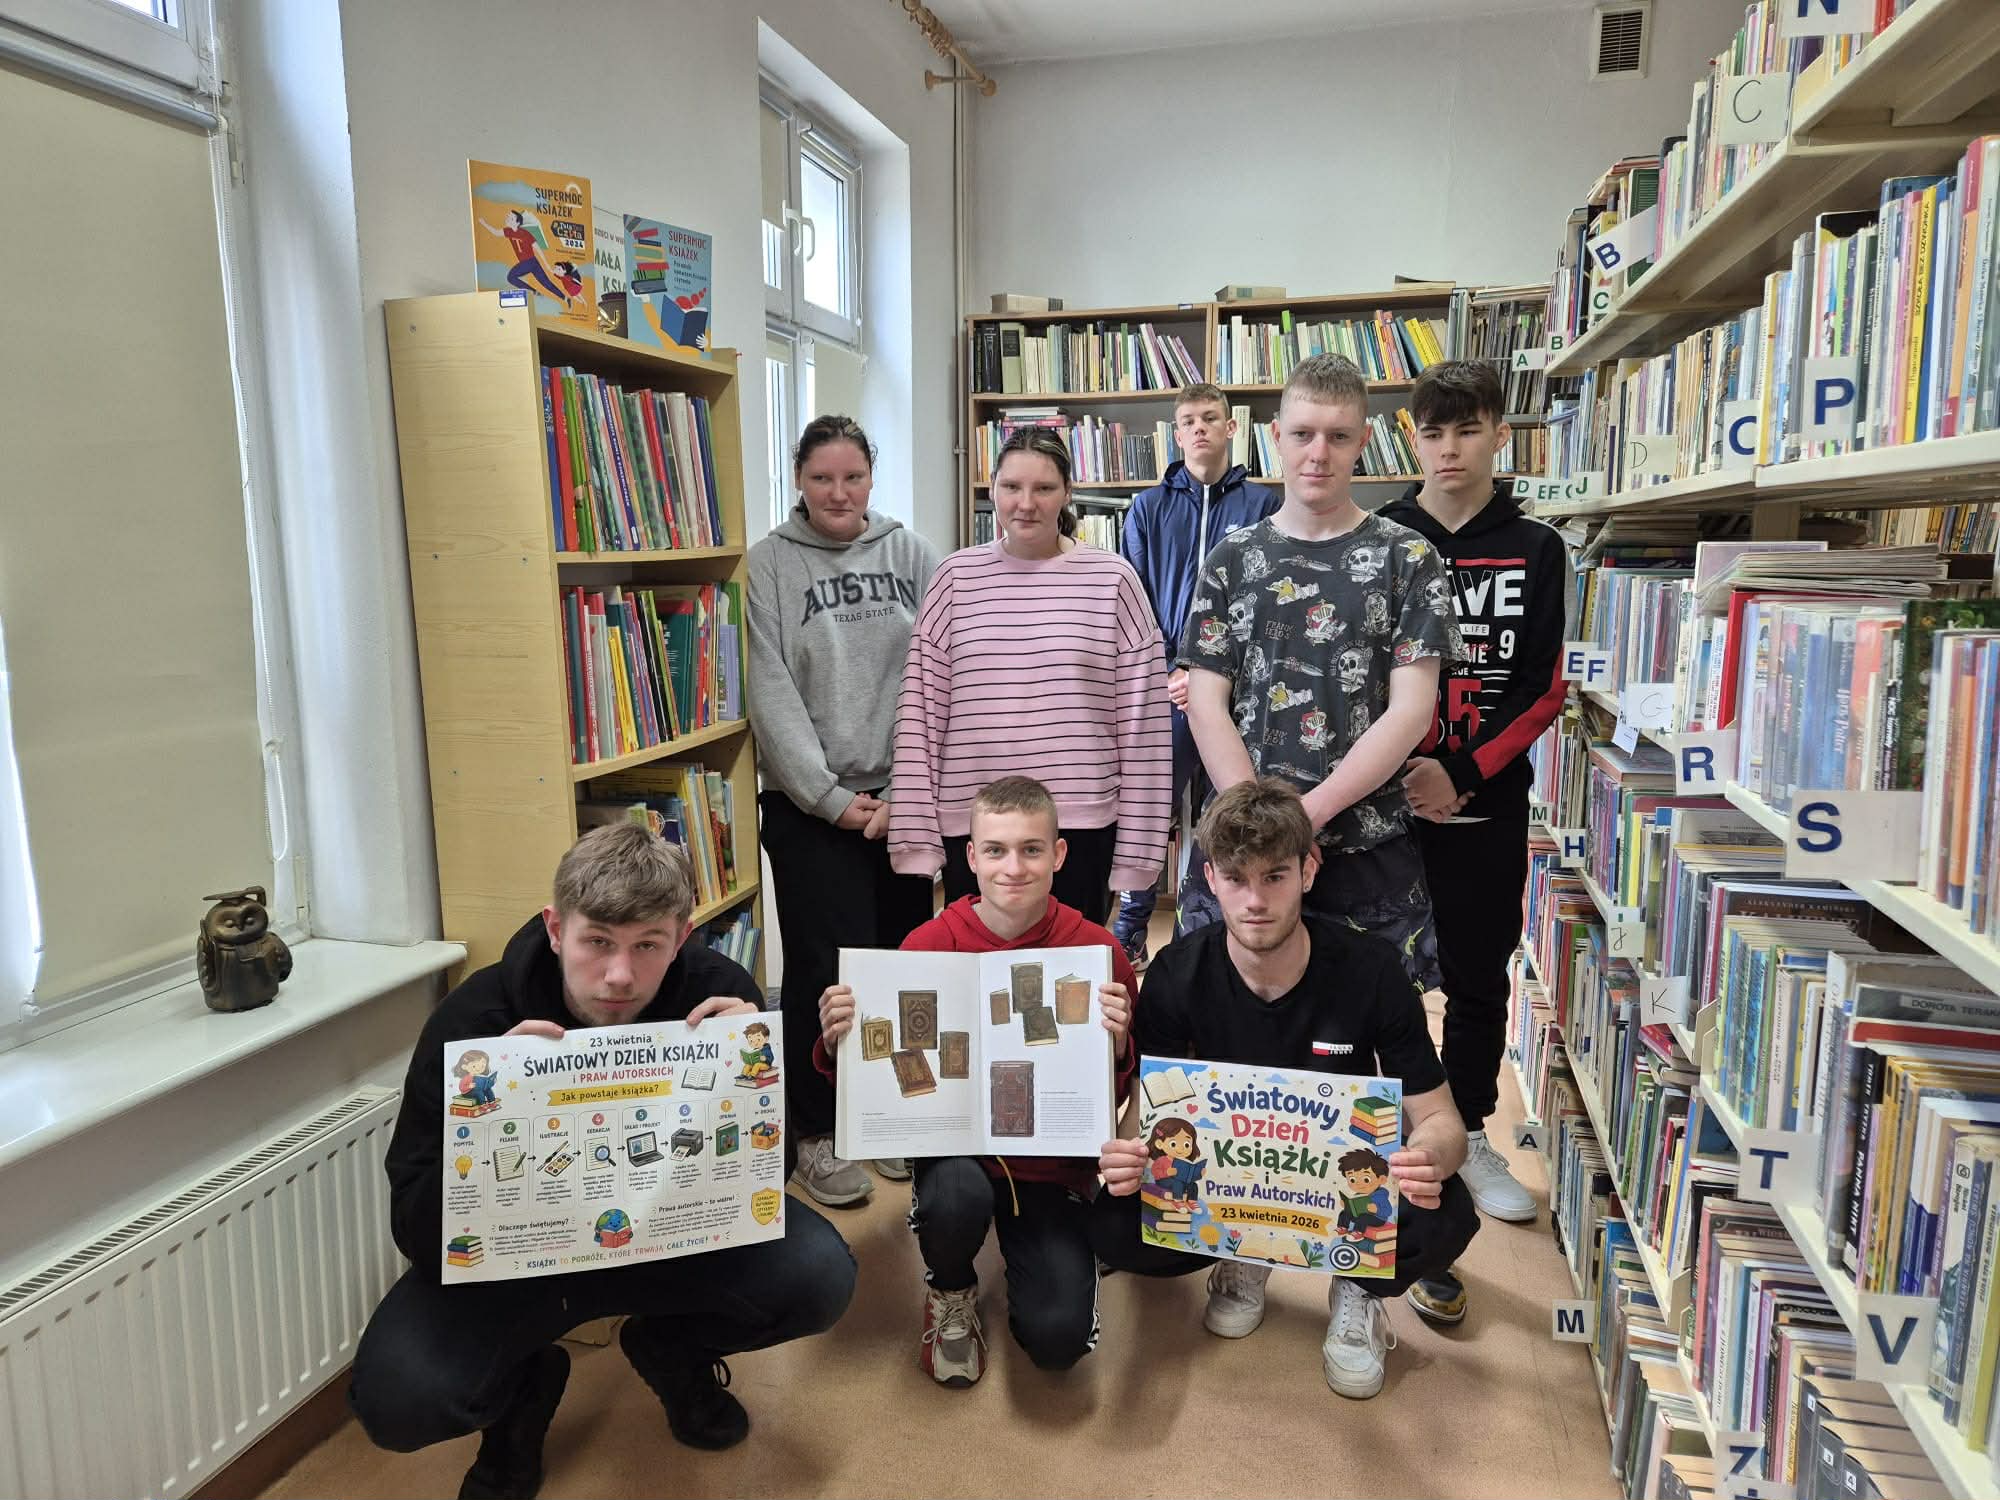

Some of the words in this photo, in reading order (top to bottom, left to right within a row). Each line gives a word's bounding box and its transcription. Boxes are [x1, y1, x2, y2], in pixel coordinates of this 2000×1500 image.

[536, 188, 582, 206] SUPERMOC
[536, 202, 573, 218] KSIĄŻEK
[668, 230, 706, 250] SUPERMOC
[1595, 242, 1620, 270] B
[1594, 292, 1609, 310] C
[1551, 336, 1563, 350] B
[1516, 354, 1528, 367] A
[1814, 378, 1856, 425] P
[1630, 442, 1648, 468] D
[1517, 480, 1530, 493] D
[1548, 485, 1560, 500] F
[1576, 477, 1588, 494] J
[801, 572, 918, 627] AUSTIN
[833, 612, 862, 622] TEXAS
[865, 606, 896, 618] STATE
[1498, 630, 1516, 660] 9
[1568, 652, 1584, 674] E
[1588, 660, 1606, 682] F
[1682, 746, 1716, 782] R
[1532, 807, 1547, 820] M
[1797, 802, 1842, 853] S
[1564, 836, 1584, 857] H
[1652, 988, 1676, 1014] K
[1912, 1000, 1956, 1012] DOROTA
[590, 1037, 603, 1047] 23
[606, 1033, 652, 1046] kwietnia
[524, 1051, 609, 1077] ŚWIATOWY
[614, 1044, 656, 1066] DZIEŃ
[663, 1040, 720, 1062] KSIĄŻKI
[580, 1072, 608, 1083] PRAW
[612, 1066, 674, 1080] AUTORSKICH
[560, 1092, 576, 1102] Jak
[580, 1088, 619, 1101] powstaje
[622, 1084, 659, 1097] książka?
[1206, 1082, 1340, 1131] Światowy
[1231, 1113, 1310, 1145] Dzień
[1519, 1134, 1538, 1148] A
[1213, 1138, 1332, 1179] Książki
[1750, 1147, 1789, 1190] T
[1265, 1172, 1270, 1184] i
[1853, 1150, 1866, 1197] PANNA
[1206, 1180, 1246, 1198] Praw
[1250, 1183, 1336, 1210] Autorskich
[529, 1219, 569, 1229] świętujemy?
[1220, 1207, 1237, 1220] 23
[1240, 1208, 1288, 1224] kwietnia
[1291, 1215, 1320, 1229] 2026
[527, 1259, 556, 1268] KSIĄŻKI
[666, 1241, 685, 1249] CAŁE
[686, 1235, 708, 1246] ŻYCIE!
[1557, 1309, 1584, 1333] M
[1866, 1314, 1919, 1365] V
